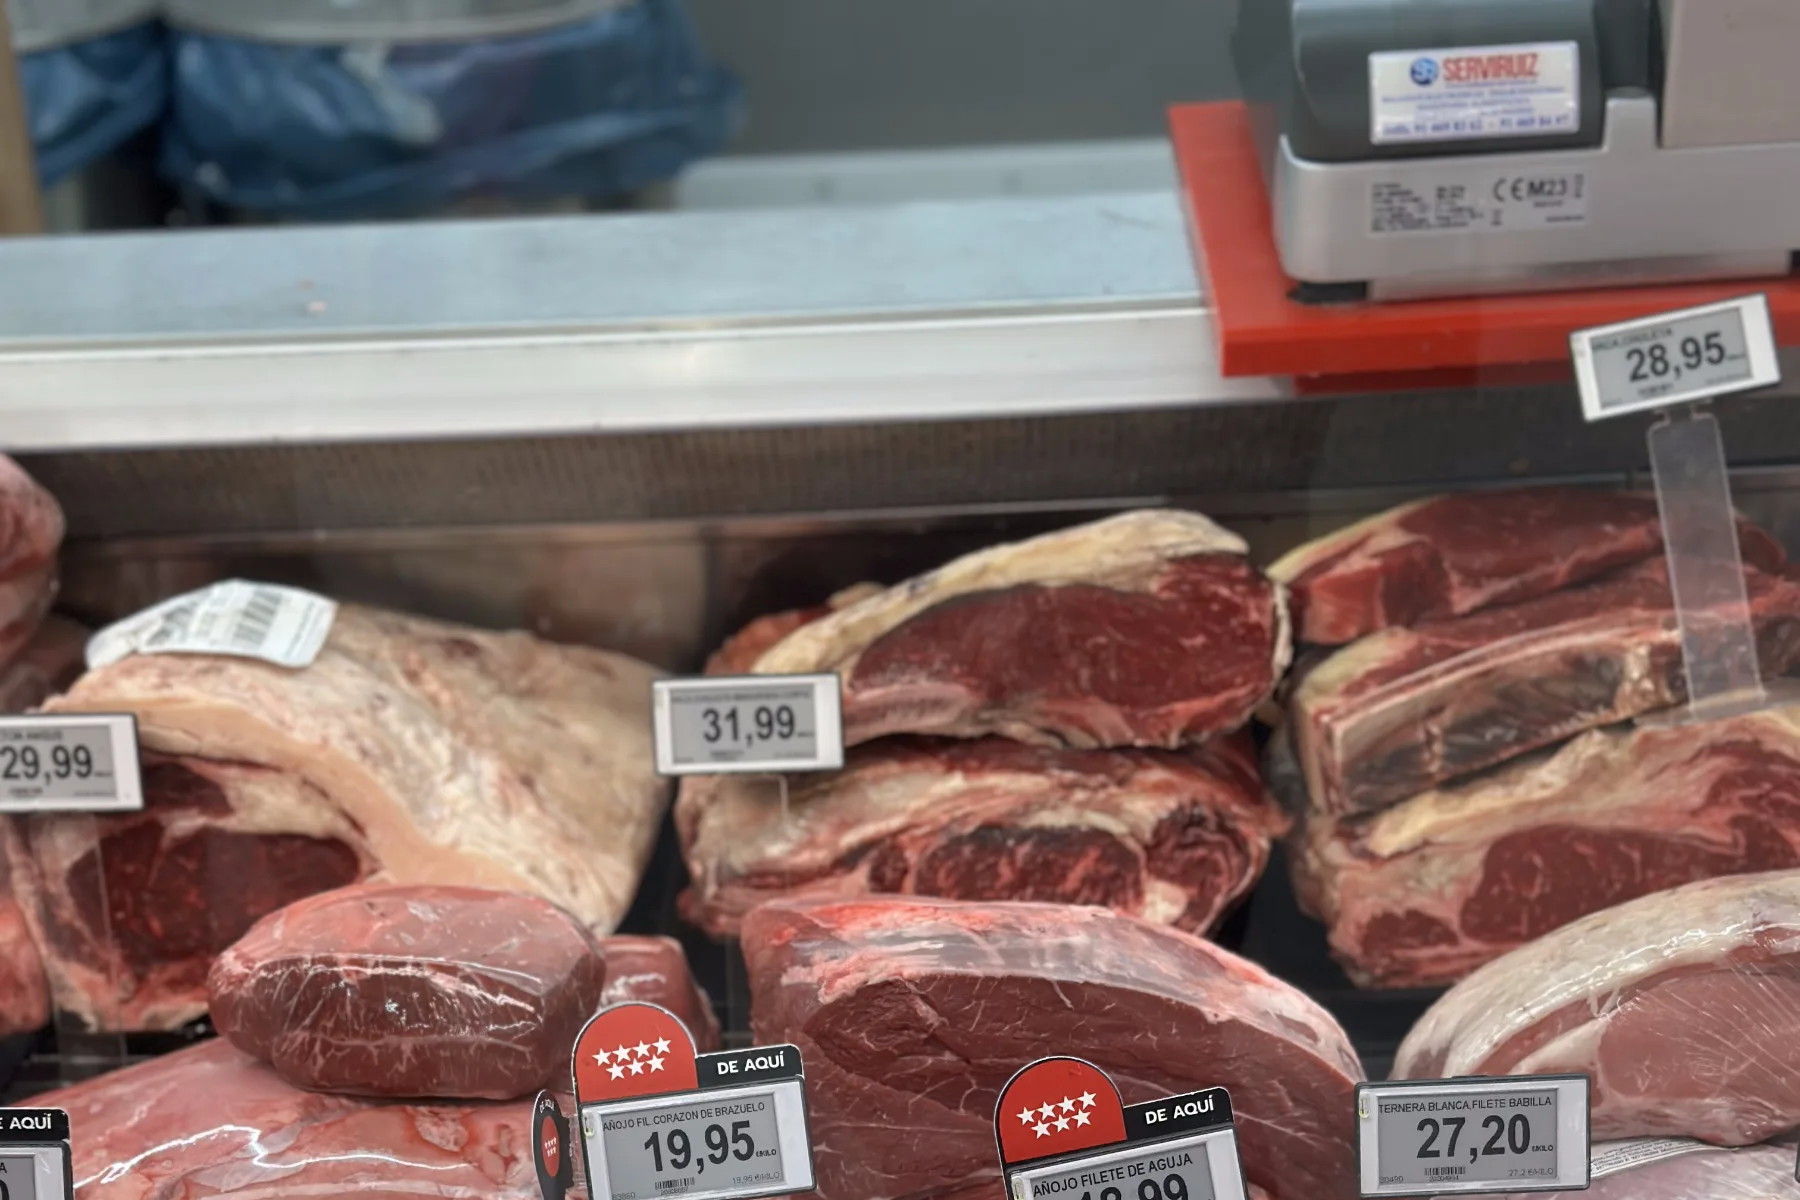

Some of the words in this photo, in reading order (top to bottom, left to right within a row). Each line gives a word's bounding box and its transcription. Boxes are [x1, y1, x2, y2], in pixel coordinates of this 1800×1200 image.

[1442, 53, 1540, 82] SERVIRUIZ
[1527, 178, 1567, 198] M23
[1626, 331, 1725, 381] 28,95
[702, 704, 796, 748] 31,99
[0, 744, 93, 787] 29,99
[717, 1060, 739, 1075] DE
[744, 1051, 785, 1073] AQUÍ
[603, 1118, 635, 1132] AÑOJO
[700, 1108, 713, 1119] DE
[715, 1102, 765, 1118] BRAZUELO
[1145, 1108, 1168, 1125] DE
[1173, 1095, 1214, 1119] AQUÍ
[1378, 1102, 1426, 1114] TERNERA
[1509, 1096, 1552, 1108] BABILLA
[9, 1113, 52, 1130] AQUÍ
[644, 1119, 755, 1174] 19,95
[1416, 1113, 1531, 1164] 27,20
[1033, 1176, 1078, 1198] AÑOJO
[1081, 1164, 1125, 1187] FILETE
[1128, 1162, 1145, 1177] DE
[1148, 1153, 1193, 1173] AGUJA
